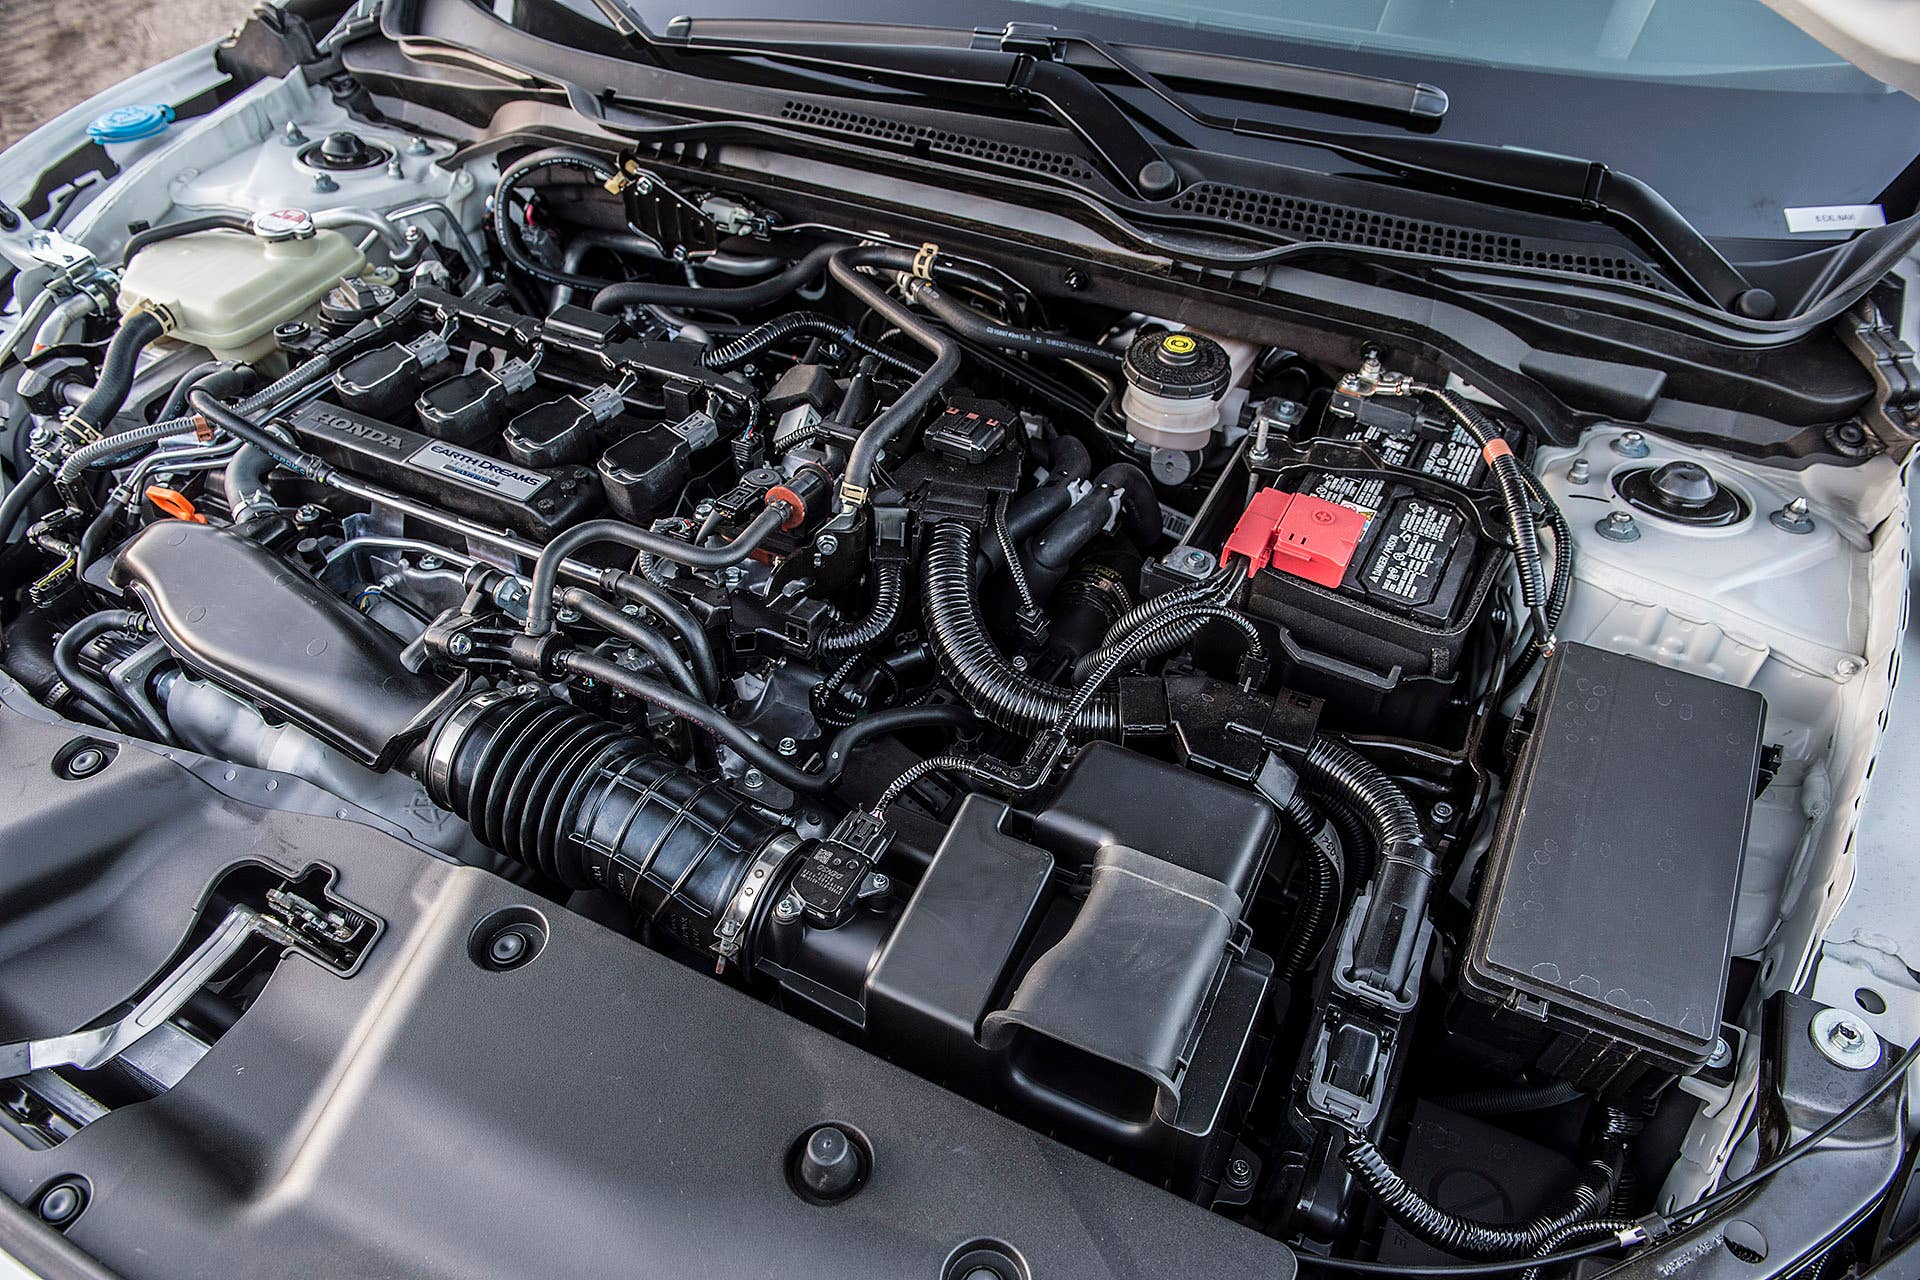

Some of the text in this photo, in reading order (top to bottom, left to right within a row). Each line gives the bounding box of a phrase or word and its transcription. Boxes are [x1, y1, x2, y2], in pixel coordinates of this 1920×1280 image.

[311, 412, 402, 449] HONDA
[430, 445, 541, 486] EARTH DREAMS
